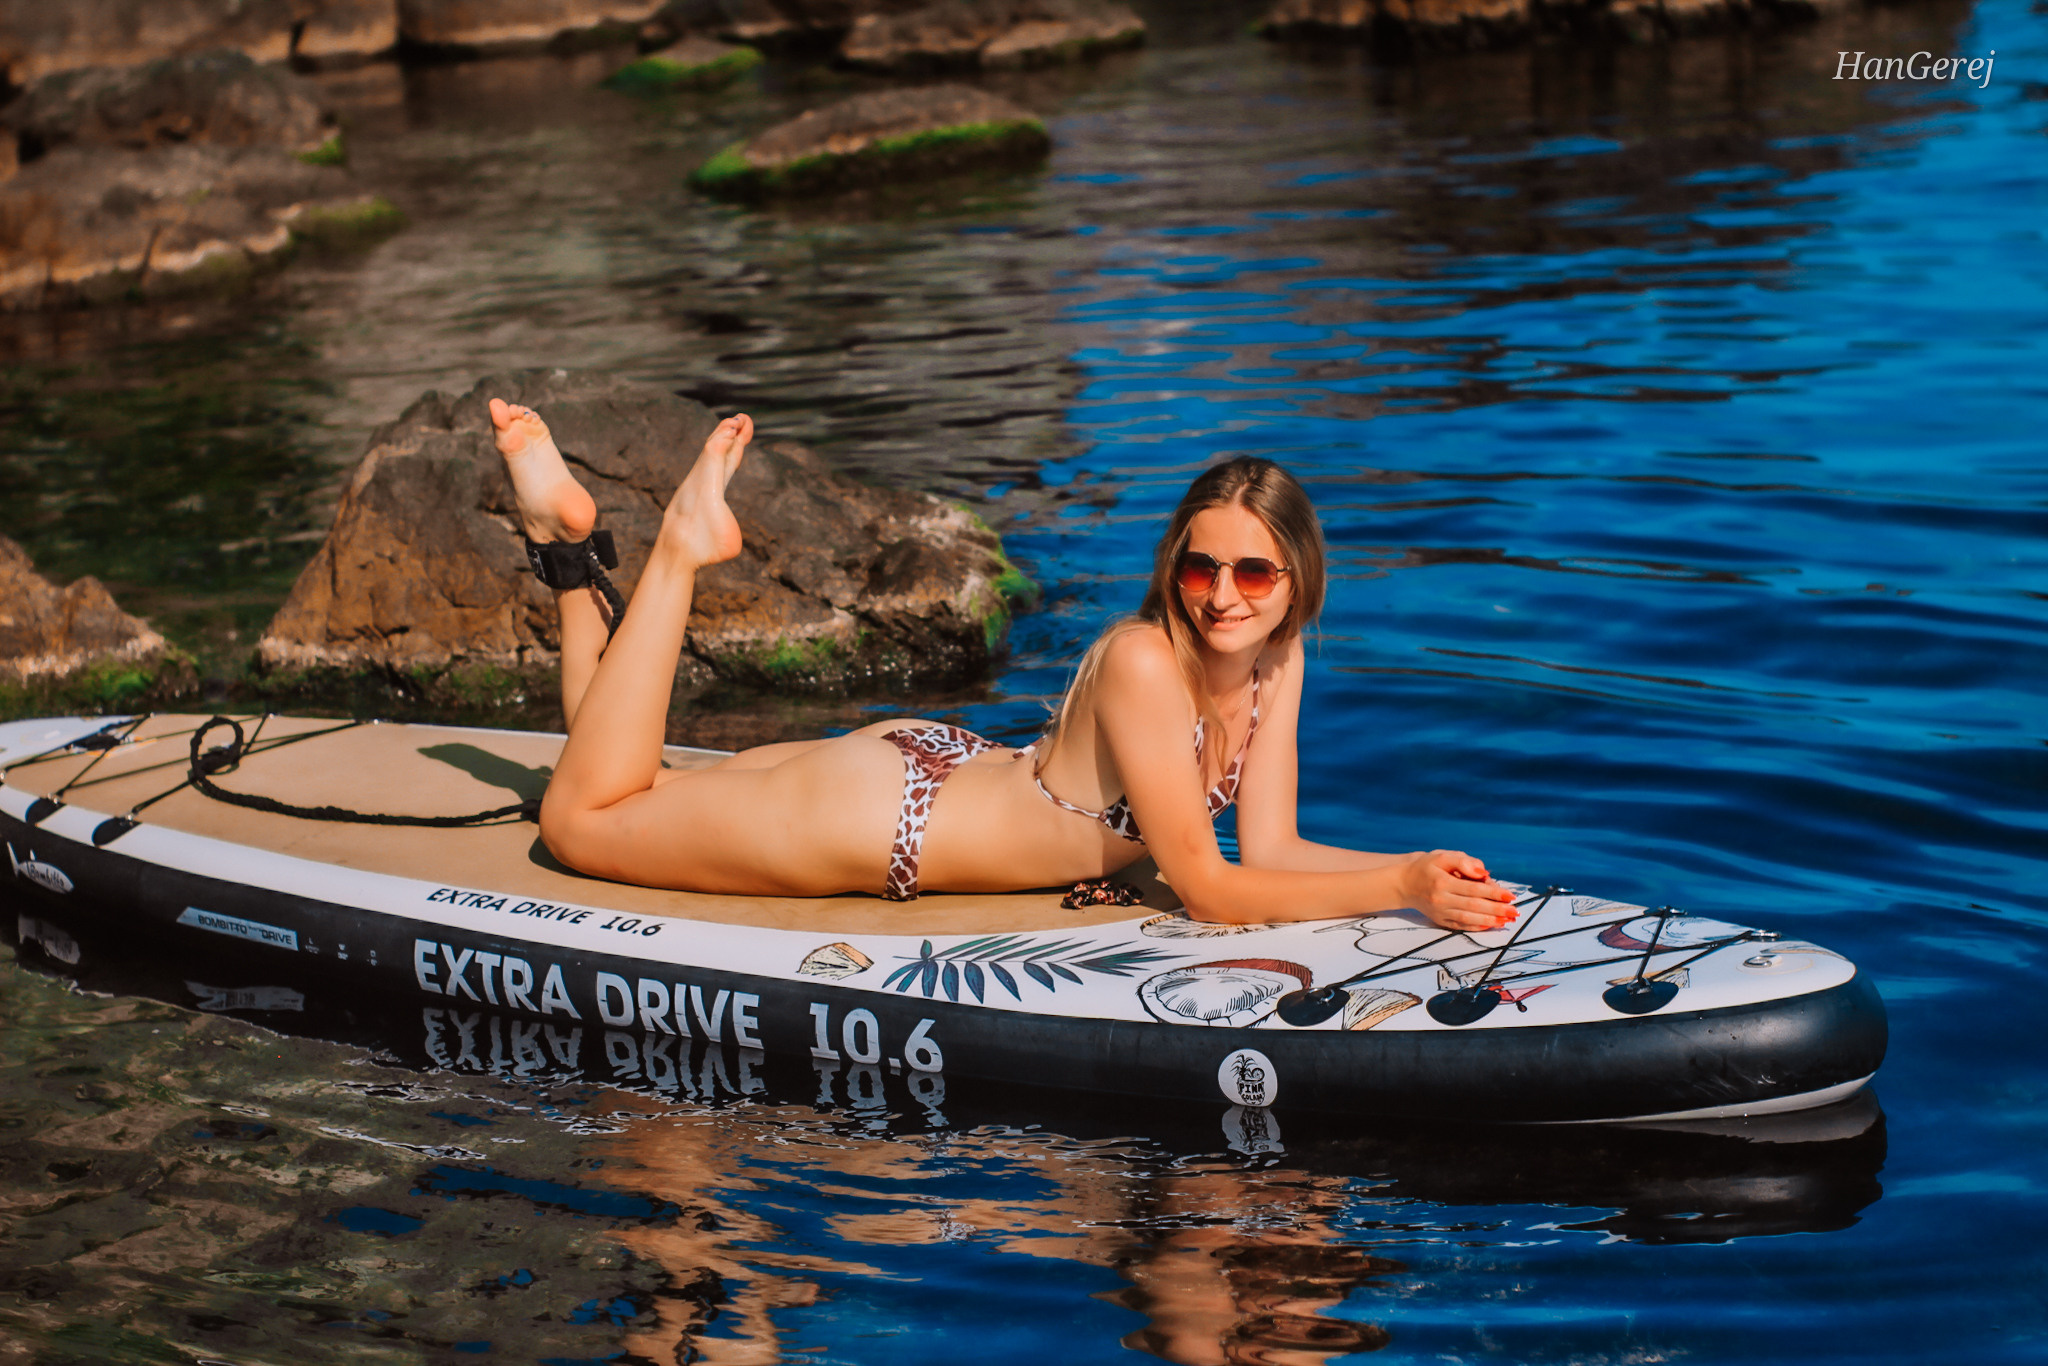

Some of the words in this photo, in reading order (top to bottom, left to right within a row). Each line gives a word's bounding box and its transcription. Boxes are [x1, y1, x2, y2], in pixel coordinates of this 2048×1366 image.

[261, 929, 293, 945] DRIVE
[426, 888, 508, 912] EXTRA
[509, 901, 595, 925] DRIVE
[600, 916, 667, 937] 10.6
[414, 938, 582, 1020] EXTRA
[596, 970, 765, 1051] DRIVE
[809, 1002, 944, 1073] 10.6
